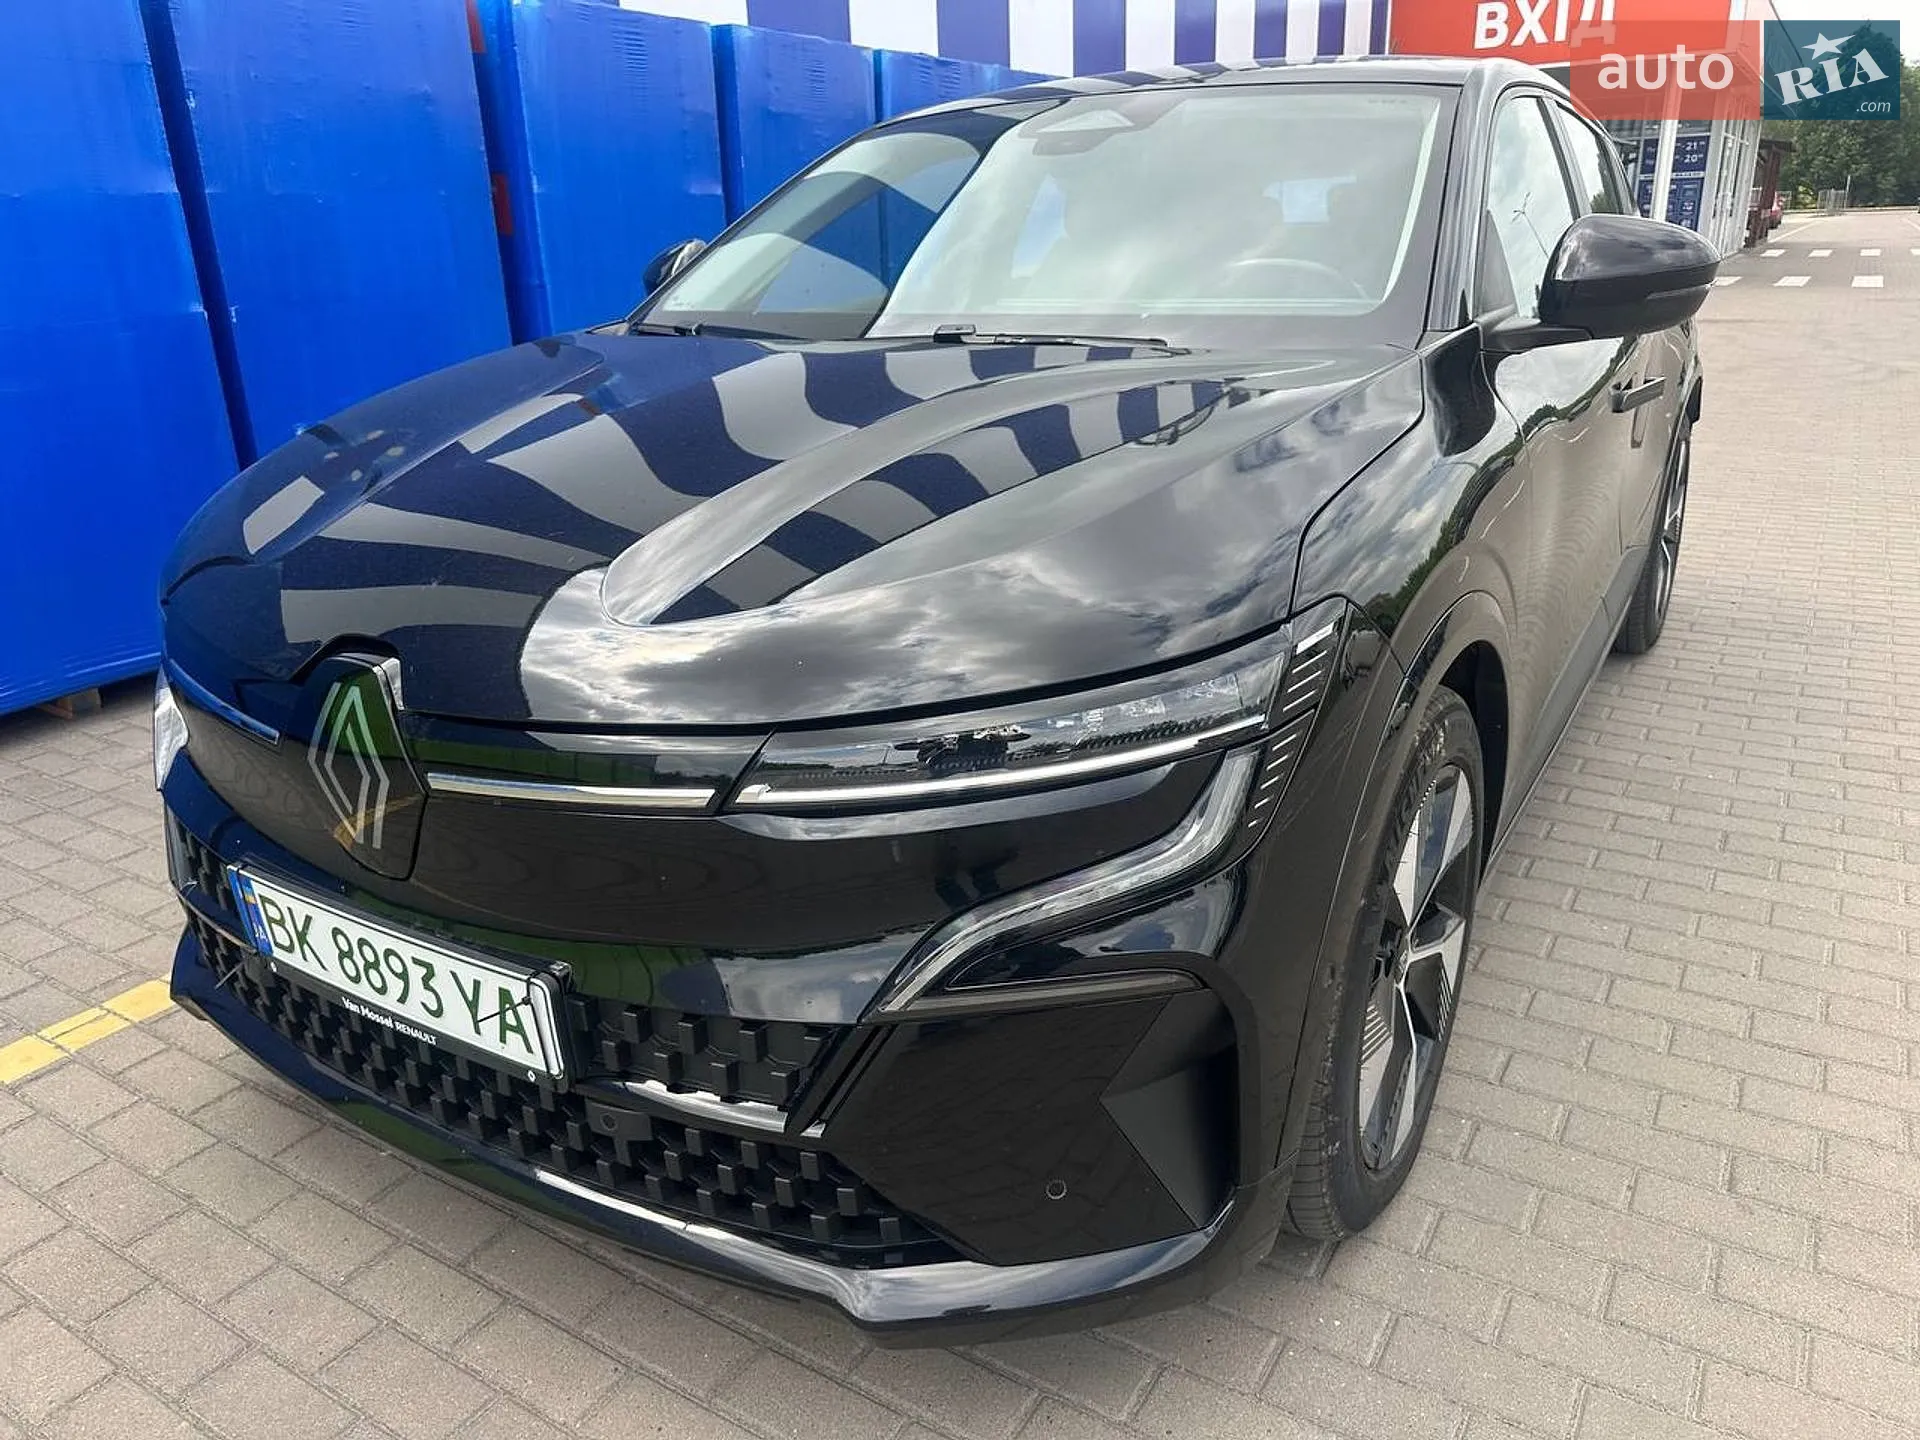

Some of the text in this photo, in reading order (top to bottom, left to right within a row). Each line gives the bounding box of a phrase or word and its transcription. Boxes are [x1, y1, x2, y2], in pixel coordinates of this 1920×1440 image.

[257, 892, 534, 1055] BK 8893 YA
[394, 1021, 437, 1046] RENAULT
